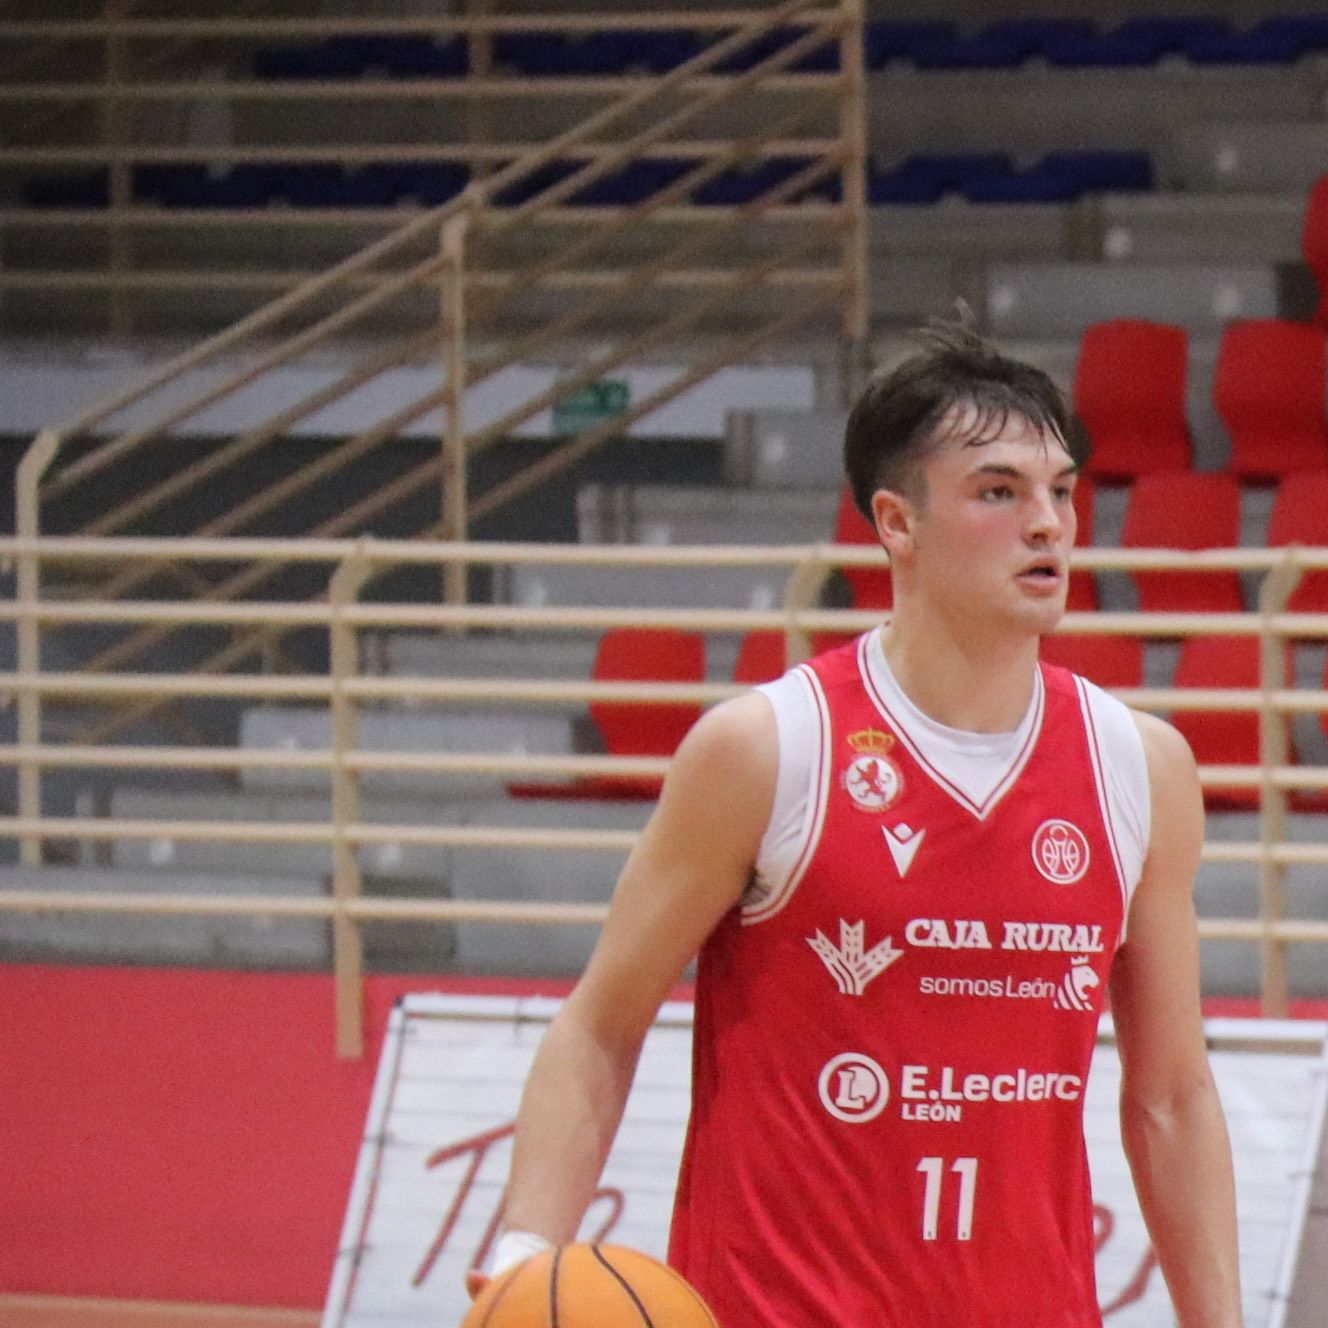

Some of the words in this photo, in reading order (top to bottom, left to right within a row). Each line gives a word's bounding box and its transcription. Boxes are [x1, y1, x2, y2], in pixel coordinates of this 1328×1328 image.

[905, 918, 993, 950] CAJA
[1001, 921, 1104, 953] RURAL
[901, 1064, 1082, 1102] E.Leclerc
[901, 1101, 962, 1122] LEÓN
[916, 1156, 978, 1241] 11
